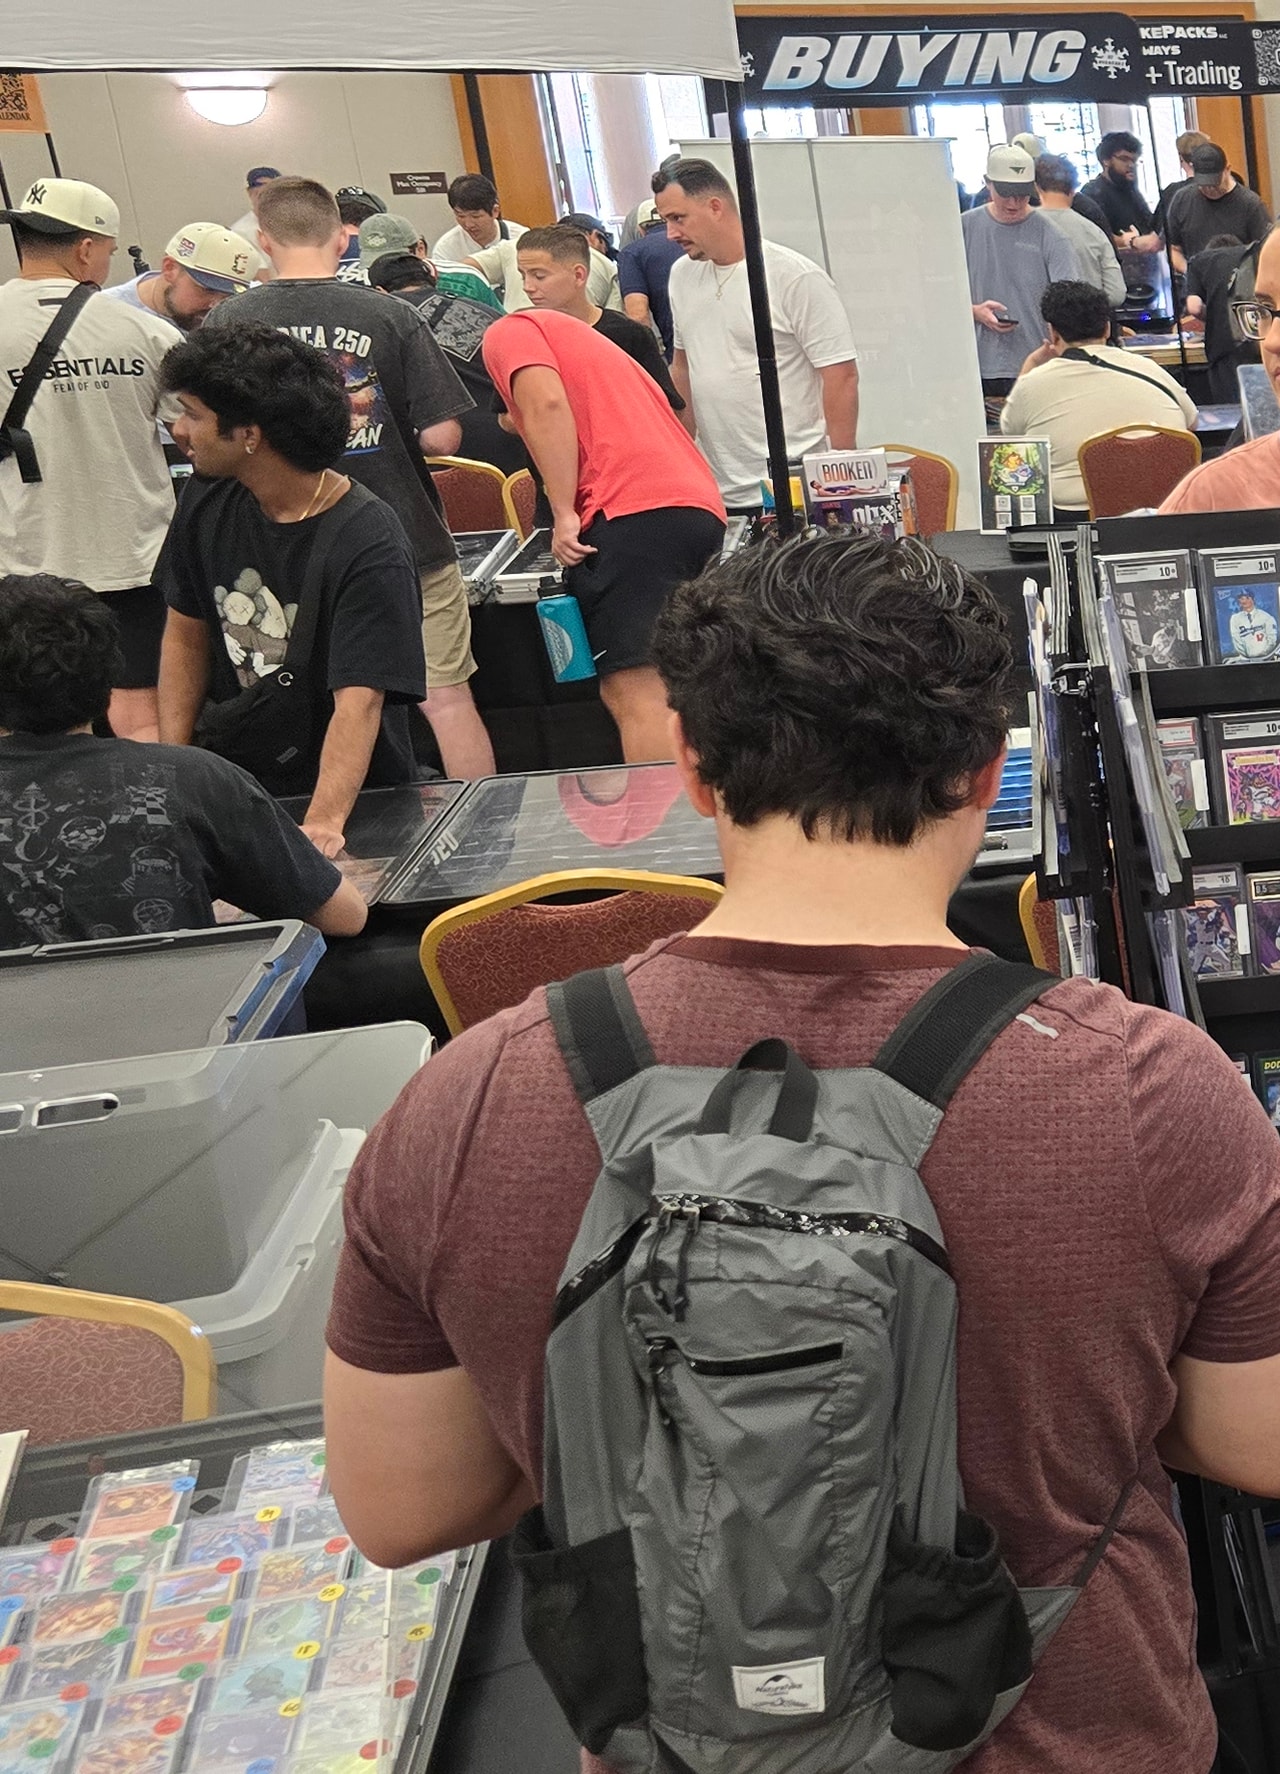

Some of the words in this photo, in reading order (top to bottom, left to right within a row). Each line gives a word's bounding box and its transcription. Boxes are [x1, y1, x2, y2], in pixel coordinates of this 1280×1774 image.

[762, 30, 1087, 89] BUYING
[1164, 60, 1243, 90] Trading
[333, 326, 373, 359] 250
[1159, 566, 1171, 577] 10
[1258, 560, 1269, 571] 10
[1266, 723, 1277, 734] 10
